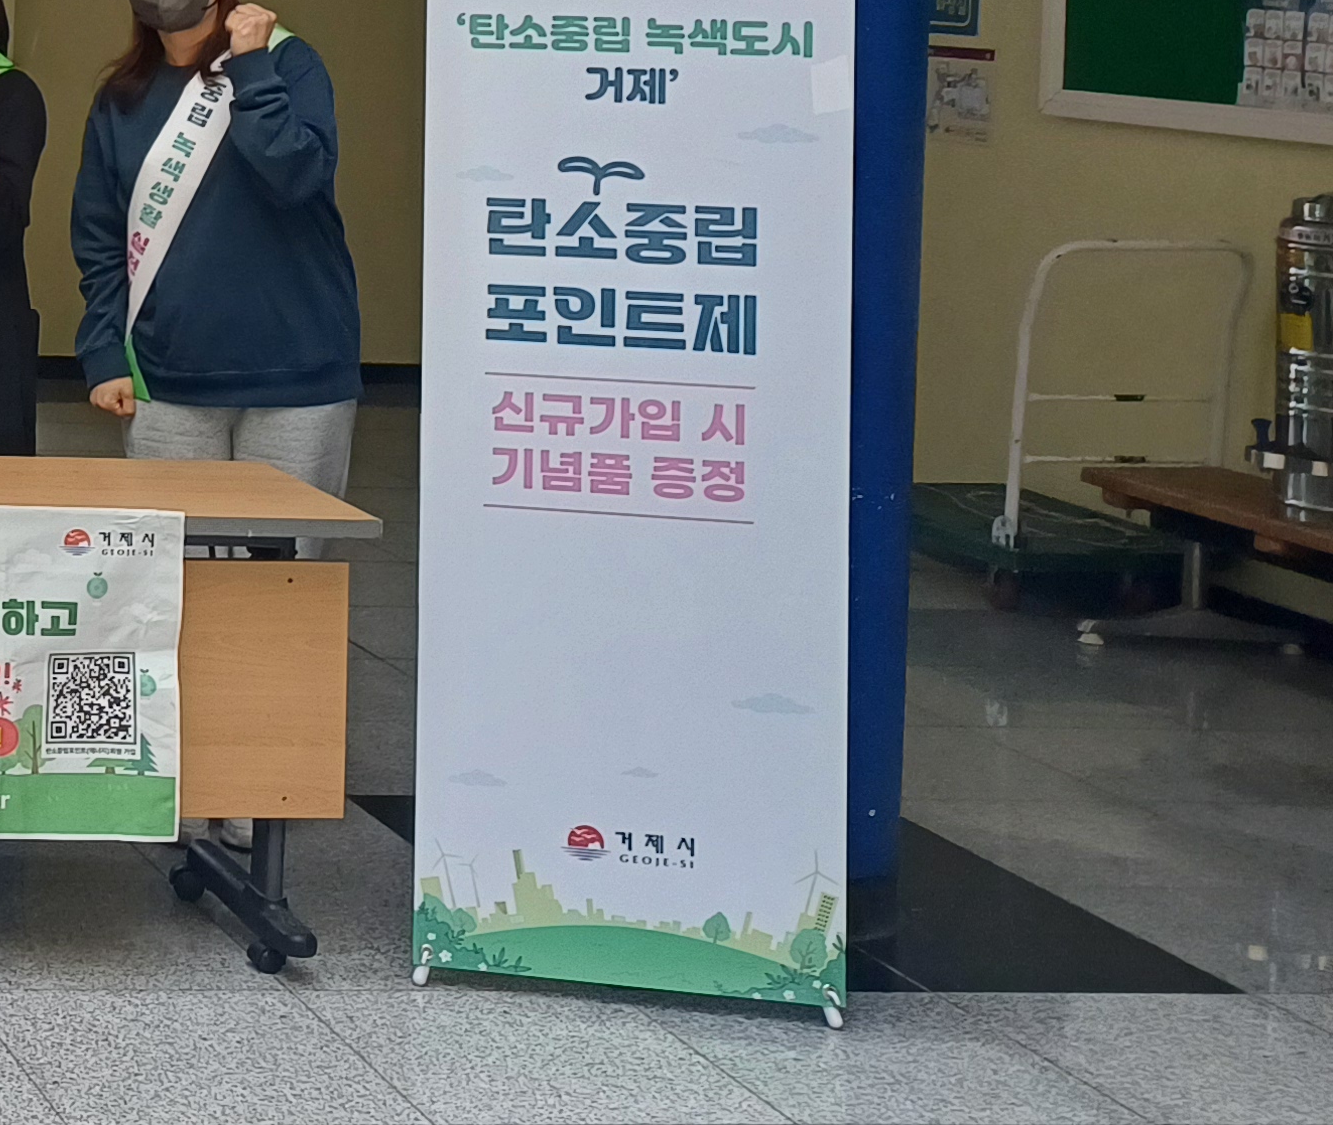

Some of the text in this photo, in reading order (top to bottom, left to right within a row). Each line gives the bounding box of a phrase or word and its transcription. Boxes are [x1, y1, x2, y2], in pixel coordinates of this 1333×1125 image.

[645, 17, 814, 58] 녹색도시
[139, 131, 197, 229] 녹색생활
[486, 196, 758, 267] 탄소중립
[485, 283, 757, 356] 포인트제
[492, 391, 746, 445] 신규가입 시
[492, 447, 746, 503] 기념품 증정
[99, 532, 155, 547] 거제시
[615, 831, 695, 857] 거제시
[619, 853, 694, 868] GEOJE-SI
